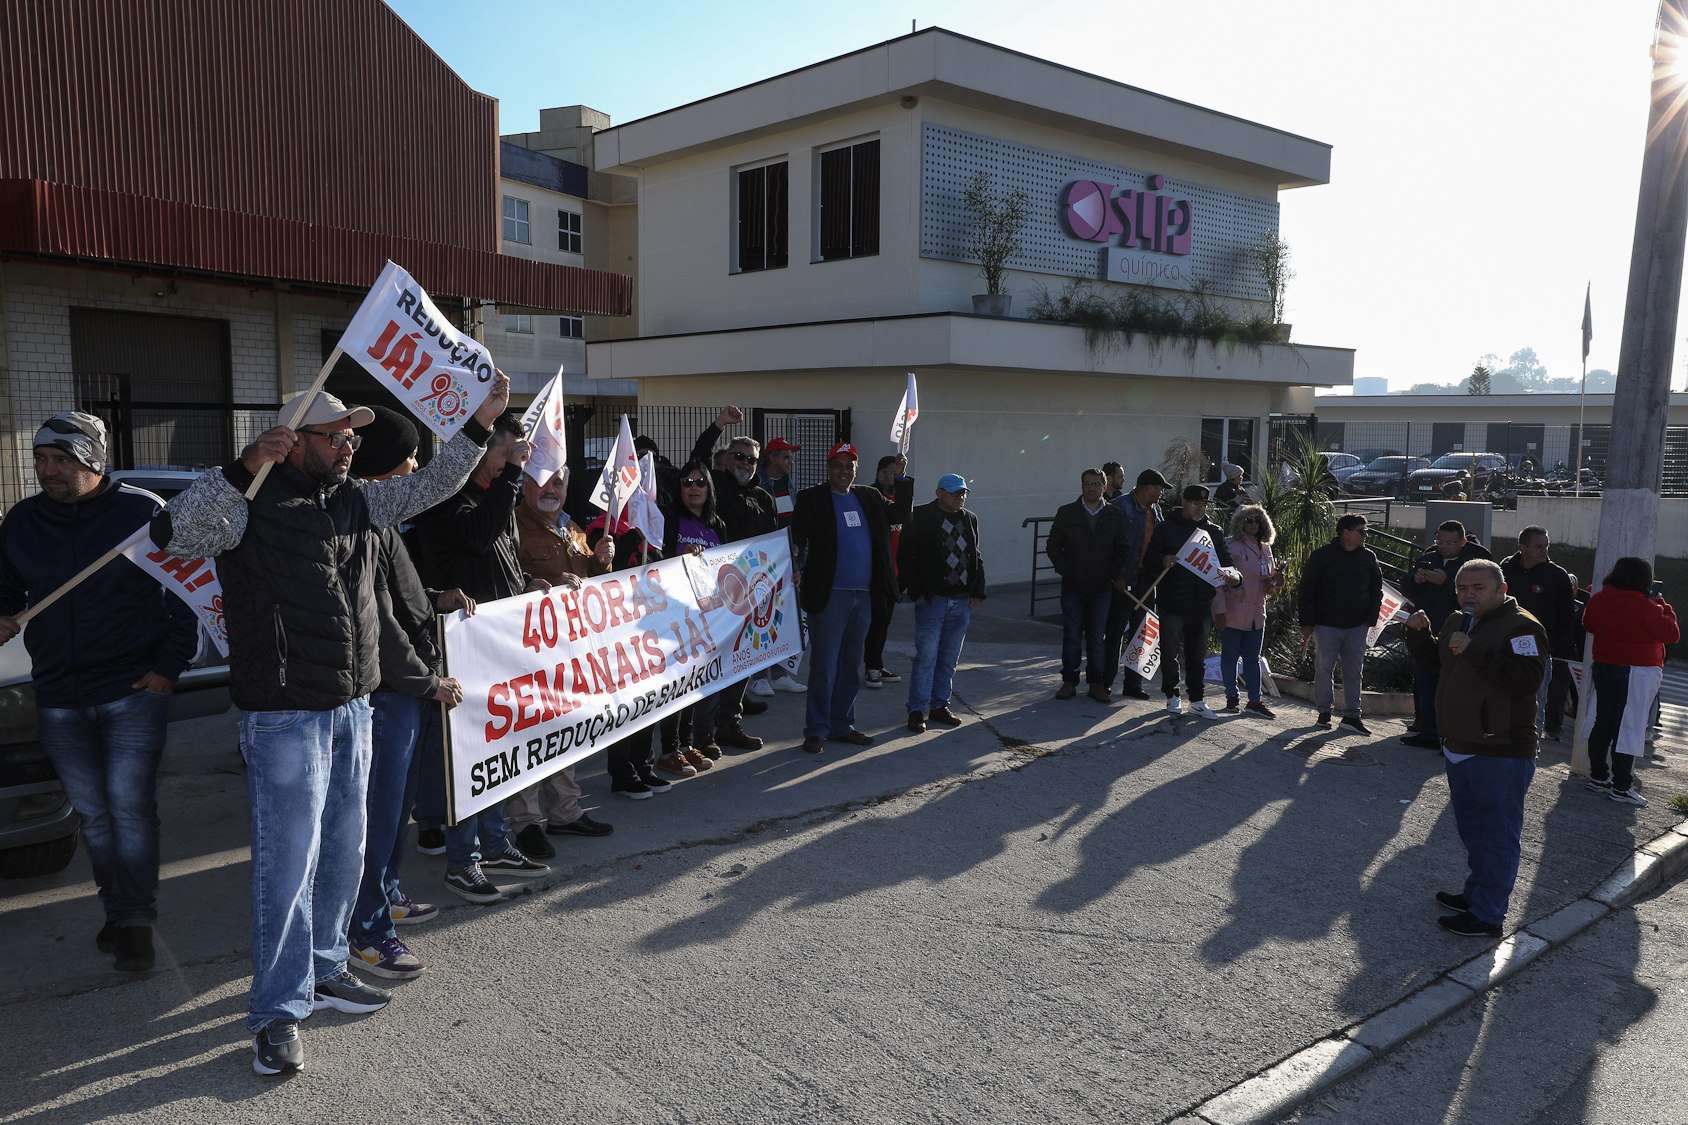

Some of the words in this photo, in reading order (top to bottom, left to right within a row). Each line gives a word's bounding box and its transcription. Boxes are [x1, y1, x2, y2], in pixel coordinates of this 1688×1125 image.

[366, 319, 433, 391] JÁ!
[396, 288, 491, 383] REDUÇÃO
[1184, 547, 1213, 575] JÁ!
[522, 596, 559, 654] 40
[560, 568, 669, 643] HORAS
[484, 628, 667, 743] SEMANAIS
[673, 607, 717, 665] JÁ!
[732, 648, 751, 665] ANOS
[732, 653, 767, 674] CONSTRUINDO
[771, 643, 790, 657] FUTURO
[1143, 645, 1160, 673] UÇÃO
[471, 754, 521, 798] SEM
[526, 703, 630, 769] REDUÇÃO
[629, 690, 656, 722] DE
[655, 657, 724, 708] SALÁRIO!
